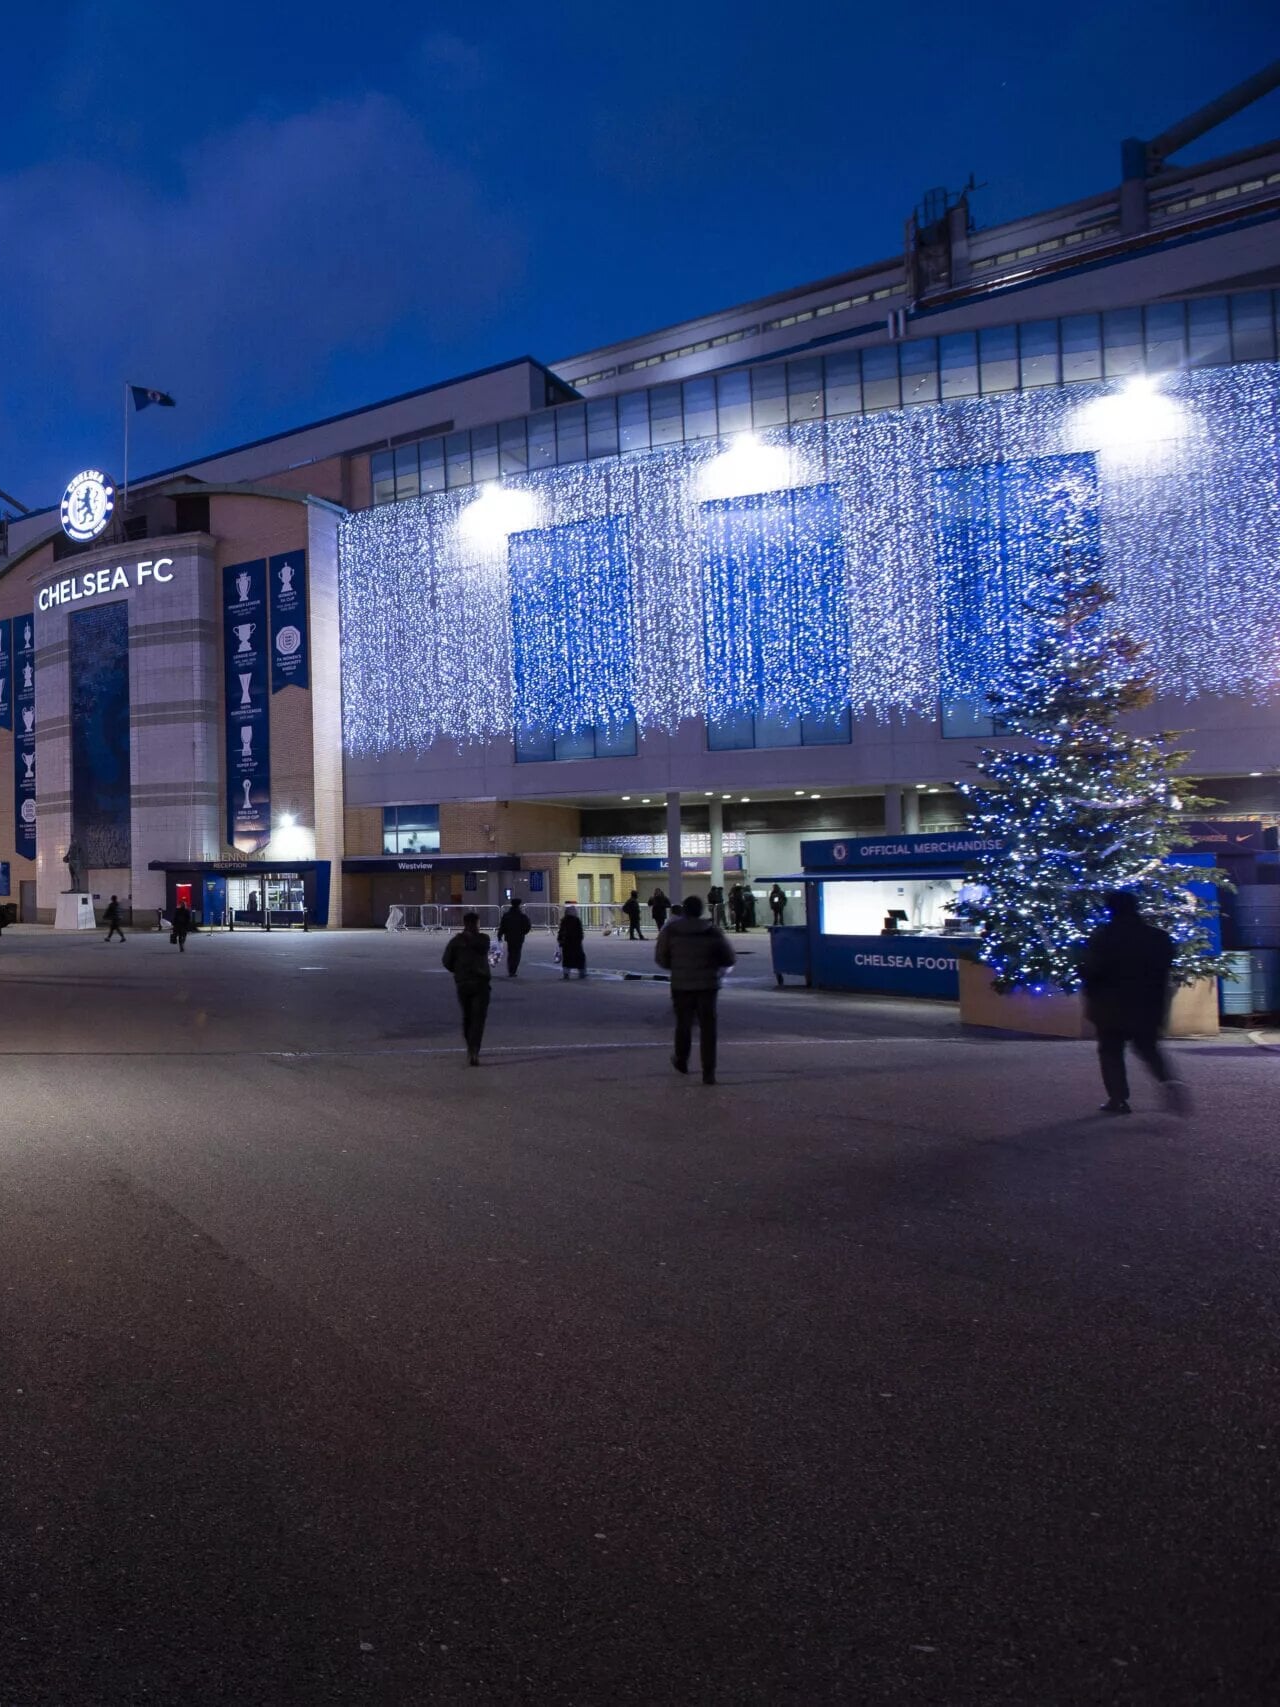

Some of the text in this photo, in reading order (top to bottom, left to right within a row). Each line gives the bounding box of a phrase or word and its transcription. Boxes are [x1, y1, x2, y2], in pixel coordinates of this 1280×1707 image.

[38, 558, 174, 611] CHELSEA FC
[860, 839, 1003, 856] OFFICIAL MERCHANDISE
[398, 861, 433, 870] Westview
[854, 953, 960, 971] CHELSEA FOOT
